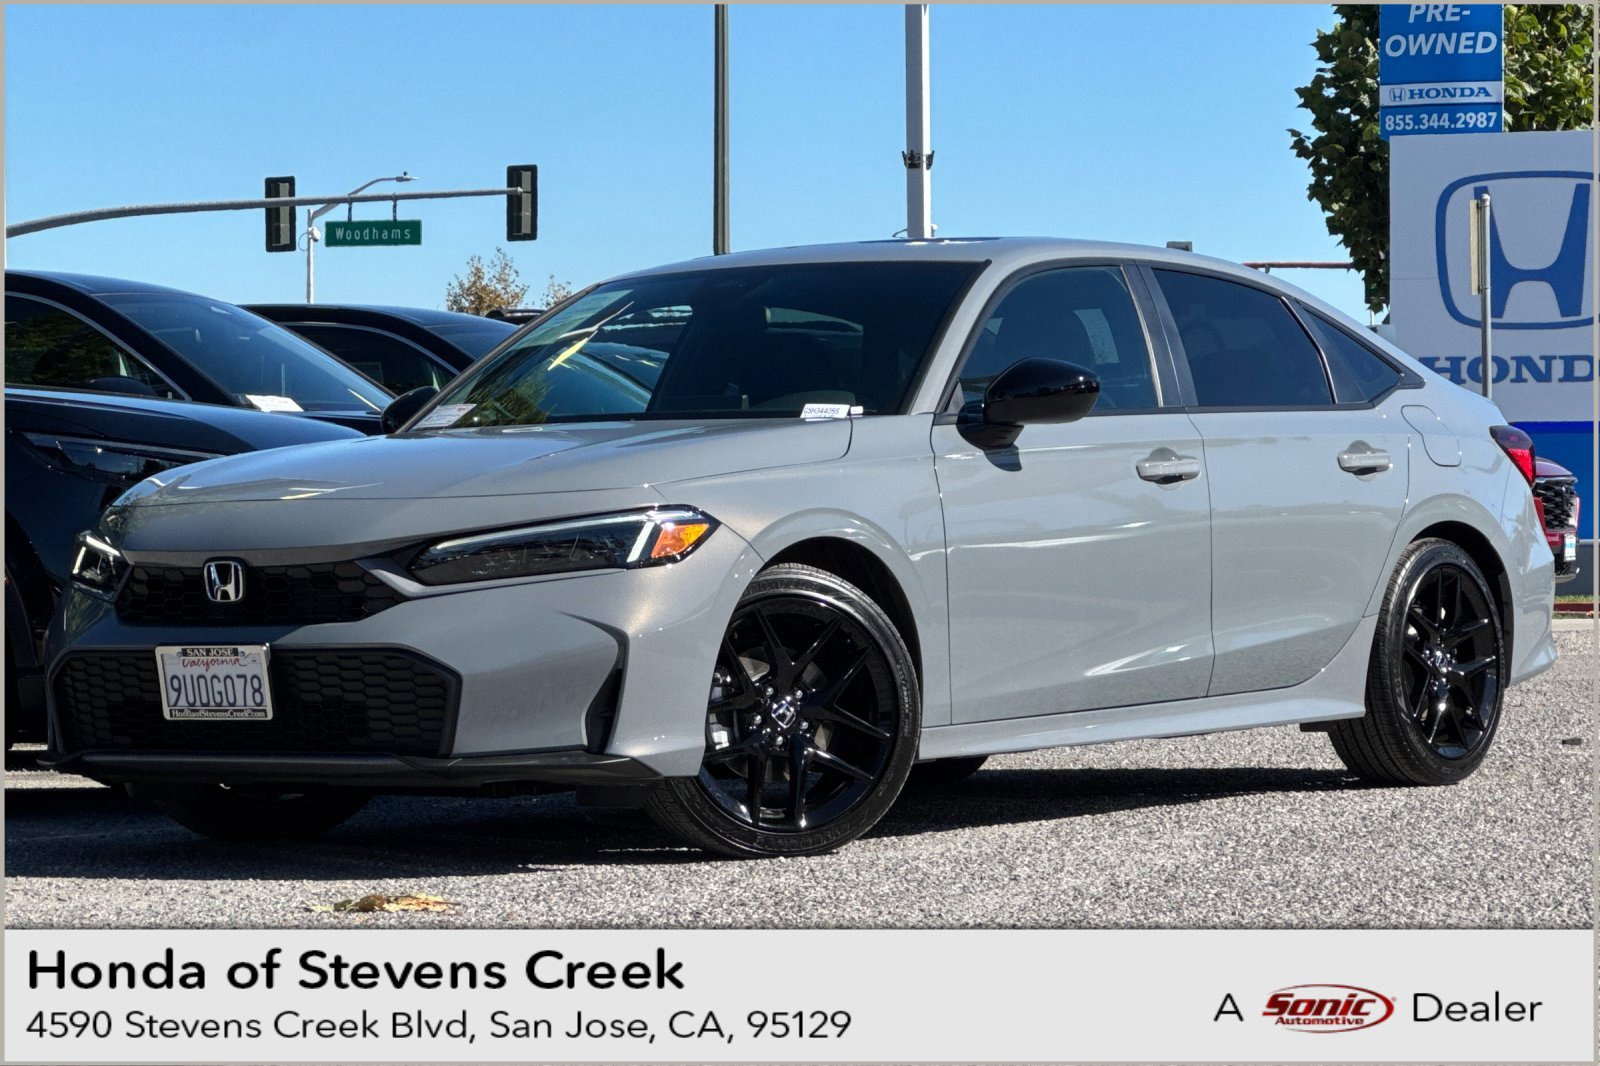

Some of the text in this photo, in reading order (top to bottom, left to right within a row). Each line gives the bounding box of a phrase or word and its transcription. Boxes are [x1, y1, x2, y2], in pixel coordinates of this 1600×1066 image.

[1408, 4, 1471, 24] PRE-
[1385, 31, 1497, 57] OWNED
[1408, 86, 1492, 101] HONDA
[1385, 111, 1498, 132] 855.344.2987
[335, 227, 411, 240] Woodhams
[186, 648, 235, 657] SAN JOSE
[182, 658, 248, 672] California
